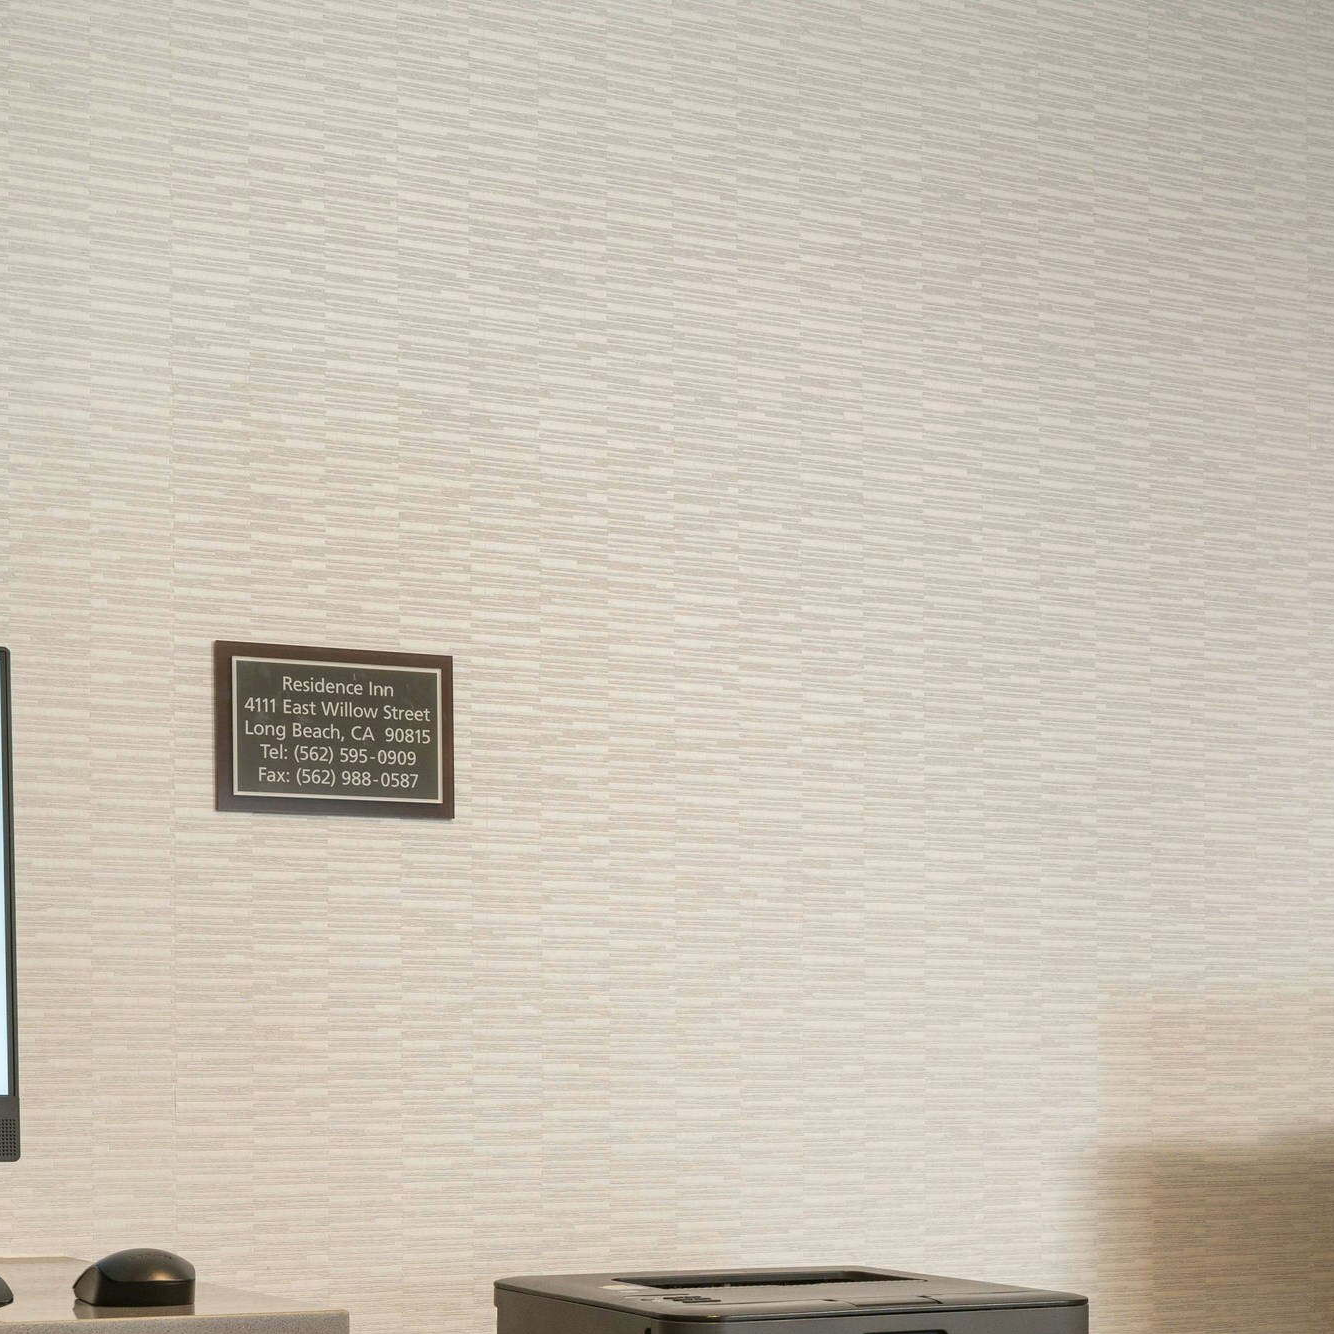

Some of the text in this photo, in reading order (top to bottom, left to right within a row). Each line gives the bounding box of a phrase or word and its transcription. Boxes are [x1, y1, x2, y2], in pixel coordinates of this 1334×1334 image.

[282, 676, 394, 697] Residence Inn
[244, 697, 431, 722] 4111 East Willow Street
[245, 720, 431, 744] Long Beach, CA 90815
[260, 744, 416, 765] Tel: (562) 595-0909
[258, 767, 418, 788] Fax: (562) 988-0587
